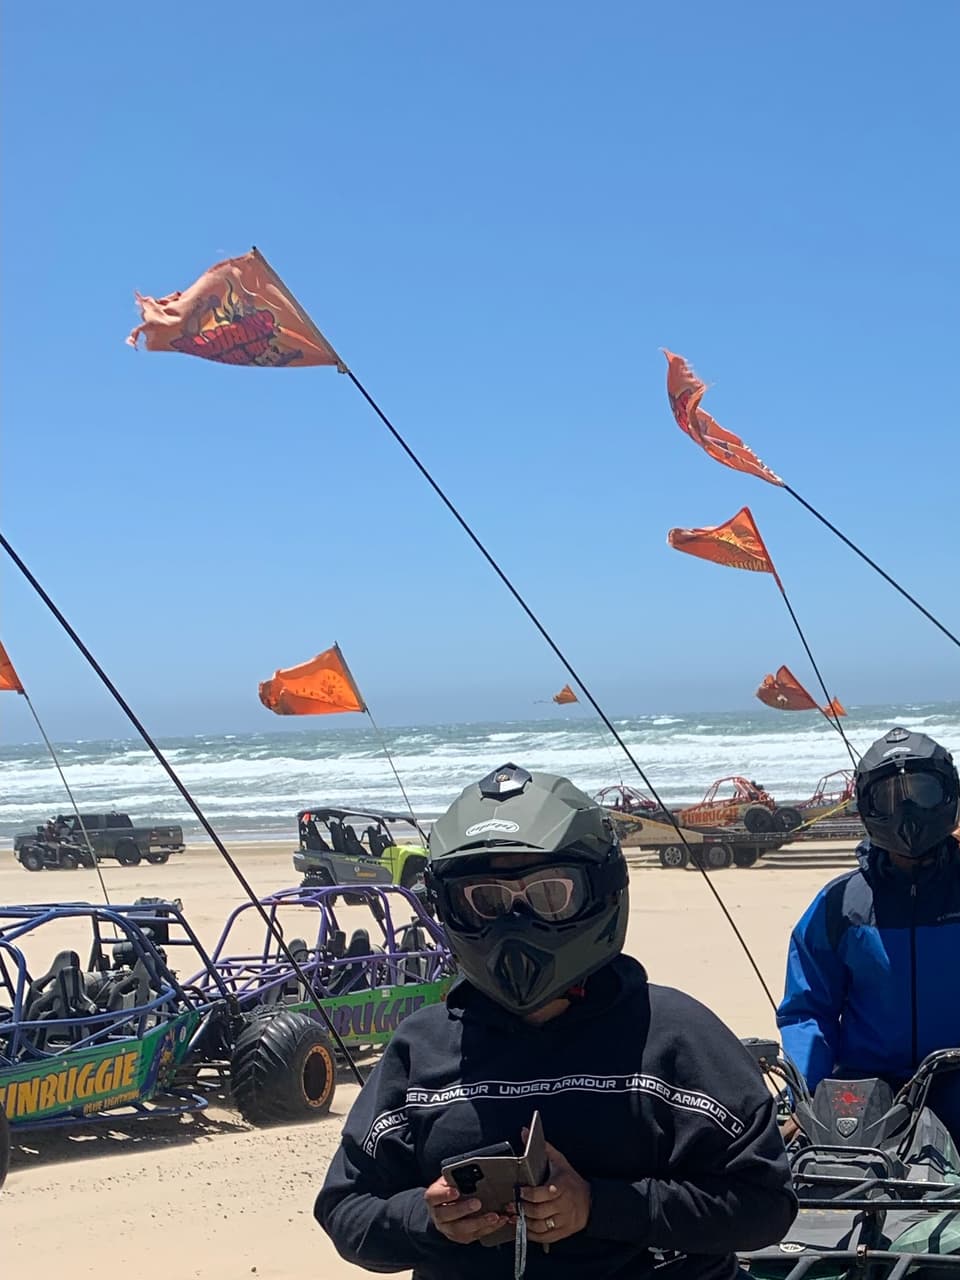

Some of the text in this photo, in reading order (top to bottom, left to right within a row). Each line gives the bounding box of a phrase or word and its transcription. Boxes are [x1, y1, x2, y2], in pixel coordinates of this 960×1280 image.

[0, 1051, 139, 1120] UNBUGGIE
[431, 1085, 489, 1103] ARMOUR
[499, 1083, 550, 1095] UNDER
[552, 1078, 616, 1091] ARMOUR
[625, 1077, 671, 1099] UNDER
[671, 1093, 727, 1122] ARMOUR
[371, 1112, 409, 1143] ARMOU
